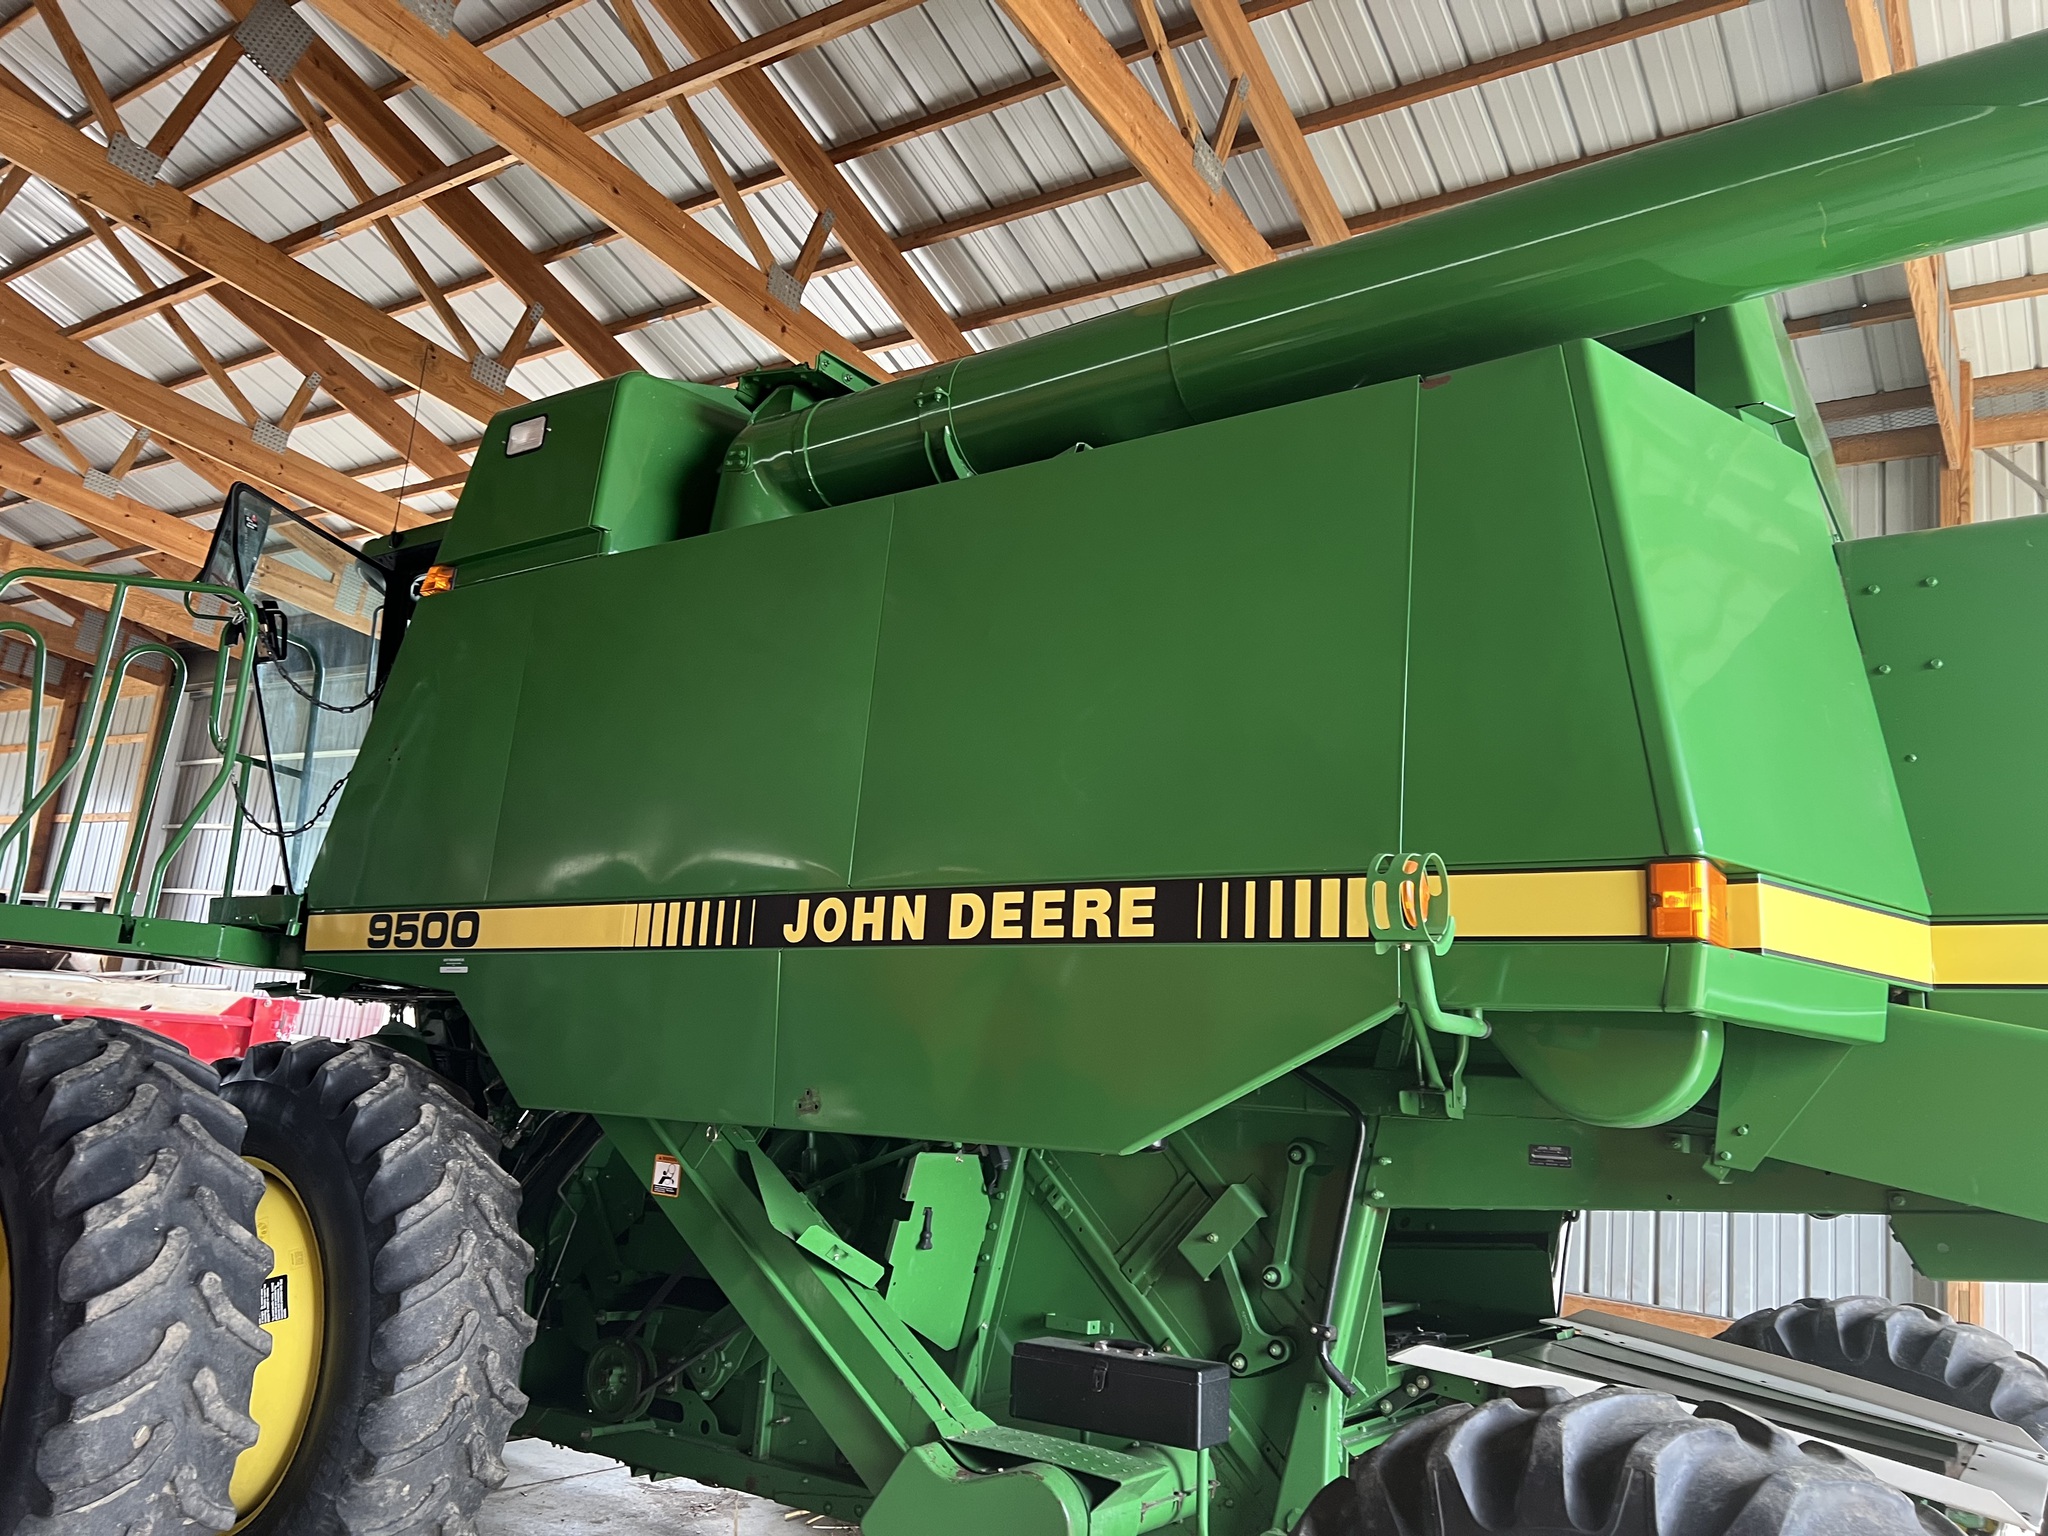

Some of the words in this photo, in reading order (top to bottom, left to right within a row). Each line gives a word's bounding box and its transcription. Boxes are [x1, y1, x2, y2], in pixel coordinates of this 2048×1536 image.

[367, 911, 480, 949] 9500
[782, 894, 927, 944] JOHN
[948, 886, 1156, 940] DEERE
